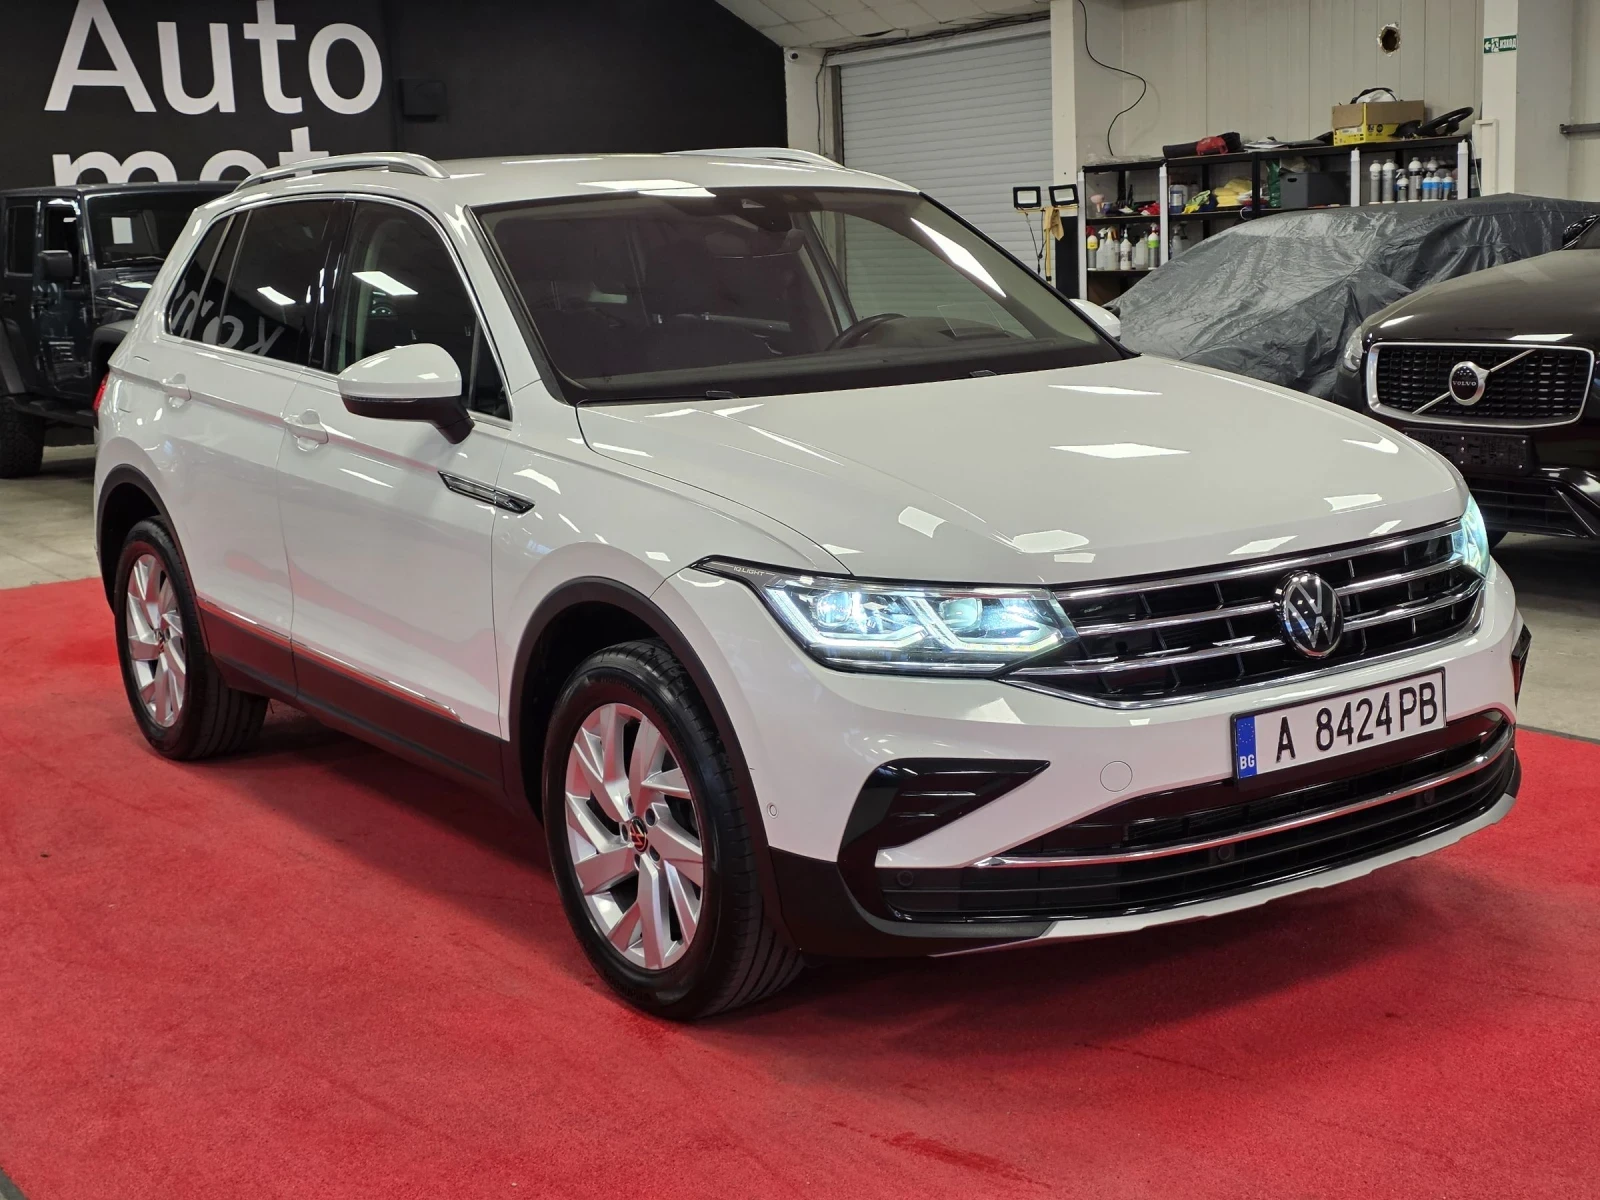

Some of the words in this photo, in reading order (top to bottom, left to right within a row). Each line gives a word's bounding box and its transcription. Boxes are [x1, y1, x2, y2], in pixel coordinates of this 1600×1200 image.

[44, 0, 383, 115] Auto
[1239, 755, 1256, 770] BG
[1276, 716, 1296, 763] A
